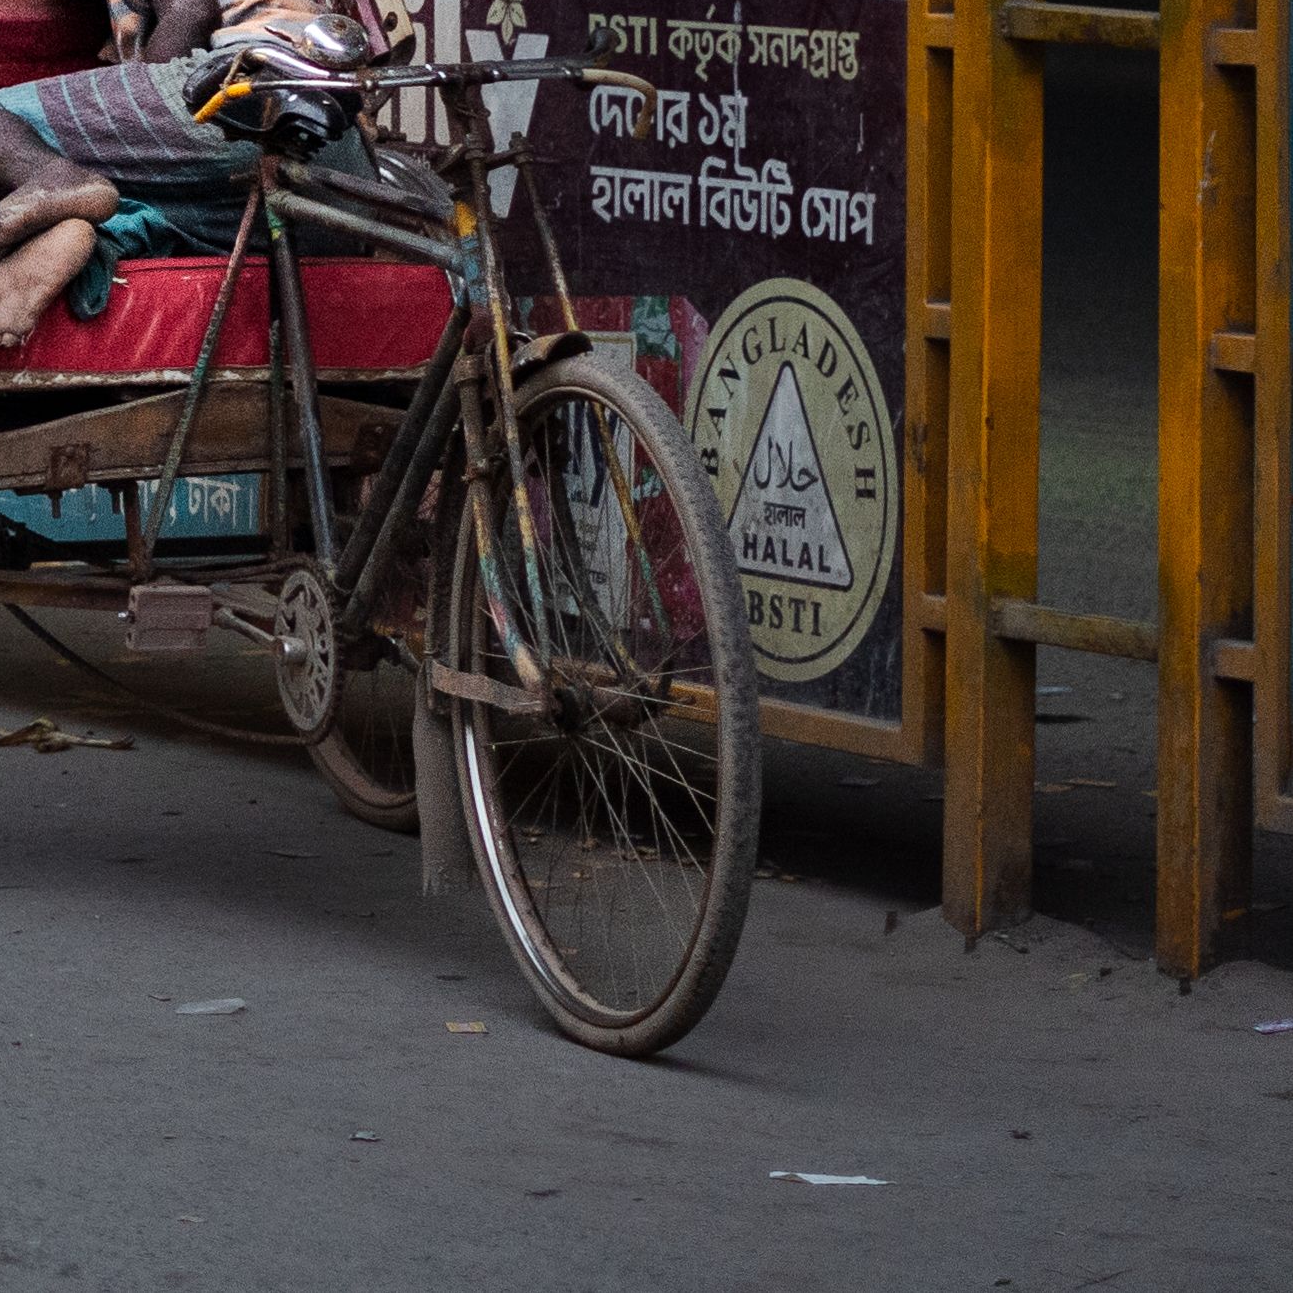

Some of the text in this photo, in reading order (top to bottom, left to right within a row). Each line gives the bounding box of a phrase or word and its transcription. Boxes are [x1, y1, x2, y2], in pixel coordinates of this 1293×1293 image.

[668, 5, 741, 82] কর্তৃক
[748, 23, 860, 81] সনদপ্রাপ্ত
[699, 89, 748, 149] ১ম
[590, 154, 876, 246] হালাল বিউটি সোপ
[700, 316, 877, 502] BANGLADESH
[753, 436, 819, 492] حلال
[763, 500, 806, 530] হালাল
[742, 532, 832, 574] HALAL
[746, 588, 823, 638] BSTI
